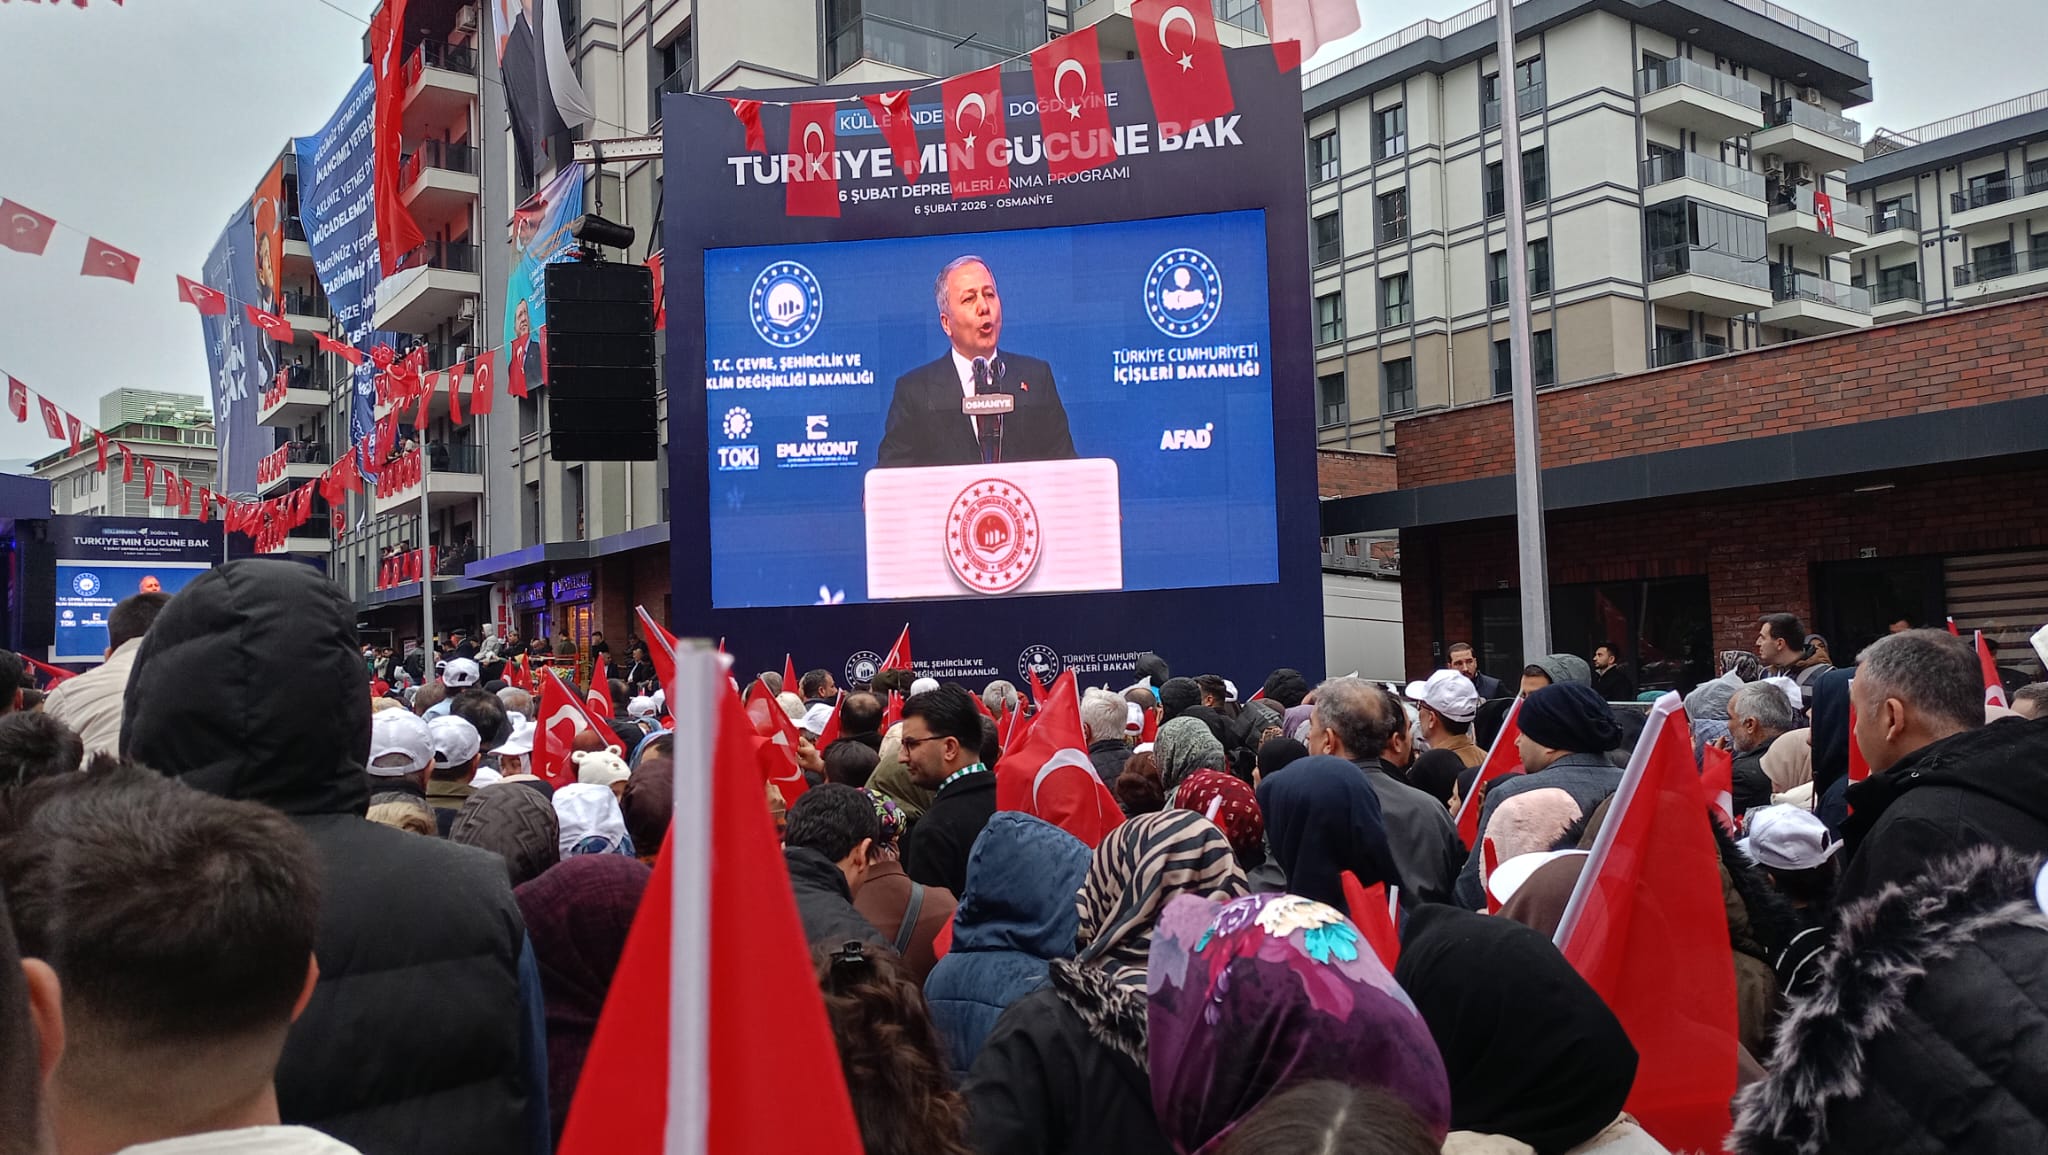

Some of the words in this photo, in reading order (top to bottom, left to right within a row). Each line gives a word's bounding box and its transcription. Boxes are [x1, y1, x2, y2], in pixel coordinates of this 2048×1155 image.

[1080, 92, 1119, 109] YİNE
[986, 124, 1149, 168] GÜCÜNE
[1158, 115, 1243, 152] BAK
[838, 190, 848, 202] 6
[851, 187, 898, 204] ŞUBAT
[902, 176, 994, 198] DEPREMLERİ
[998, 174, 1043, 190] ANMA
[1048, 166, 1130, 186] PROGRAMI
[914, 205, 921, 215] 6
[924, 203, 958, 216] ŞUBAT
[961, 201, 987, 212] 2026
[996, 194, 1053, 209] OSMANİYE
[713, 358, 734, 371] T.C.
[736, 357, 777, 373] ÇEVRE,
[780, 353, 845, 371] ŞEHİRCİLİK
[845, 354, 861, 367] VE
[1113, 347, 1165, 364] TÜRKİYE
[1168, 342, 1258, 361] CUMHURİYETİ
[736, 372, 806, 390] DEĞİŞİKLİĞİ
[809, 370, 874, 386] BAKANLIĞI
[1114, 364, 1173, 384] İÇİŞLERİ
[1177, 360, 1259, 379] BAKANLIĞI
[1160, 426, 1213, 450] AFAD
[777, 442, 817, 458] EMLAK
[818, 441, 858, 456] KONUT
[931, 658, 972, 669] ŞEHİRCİLİK
[1062, 653, 1096, 663] TÜRKİYE
[1103, 662, 1136, 671] BAKAN
[957, 667, 999, 677] BAKANLIĞI
